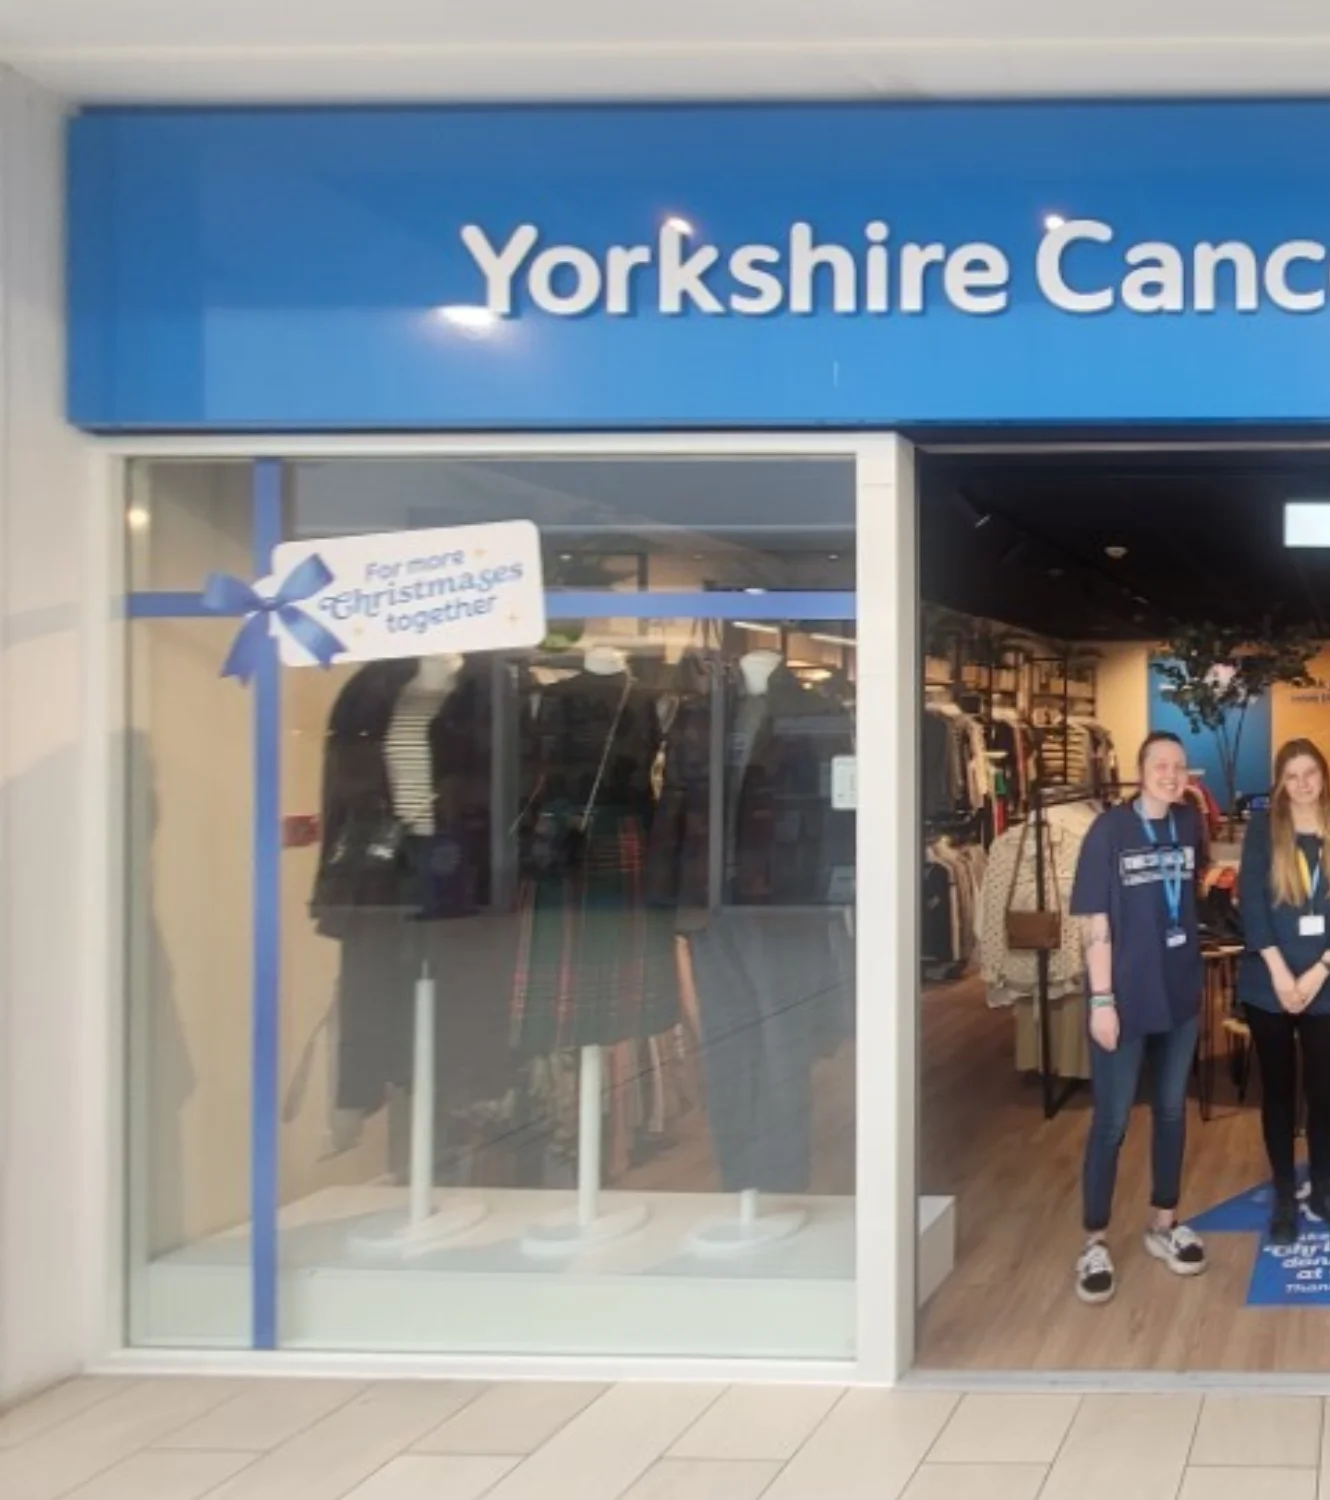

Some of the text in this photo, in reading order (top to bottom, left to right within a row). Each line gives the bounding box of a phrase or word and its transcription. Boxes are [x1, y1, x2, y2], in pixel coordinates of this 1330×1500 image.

[460, 221, 1008, 316] Yorkshire
[364, 551, 465, 580] For more
[319, 561, 524, 620] Christmases
[386, 594, 499, 633] together
[1296, 1267, 1323, 1281] at
